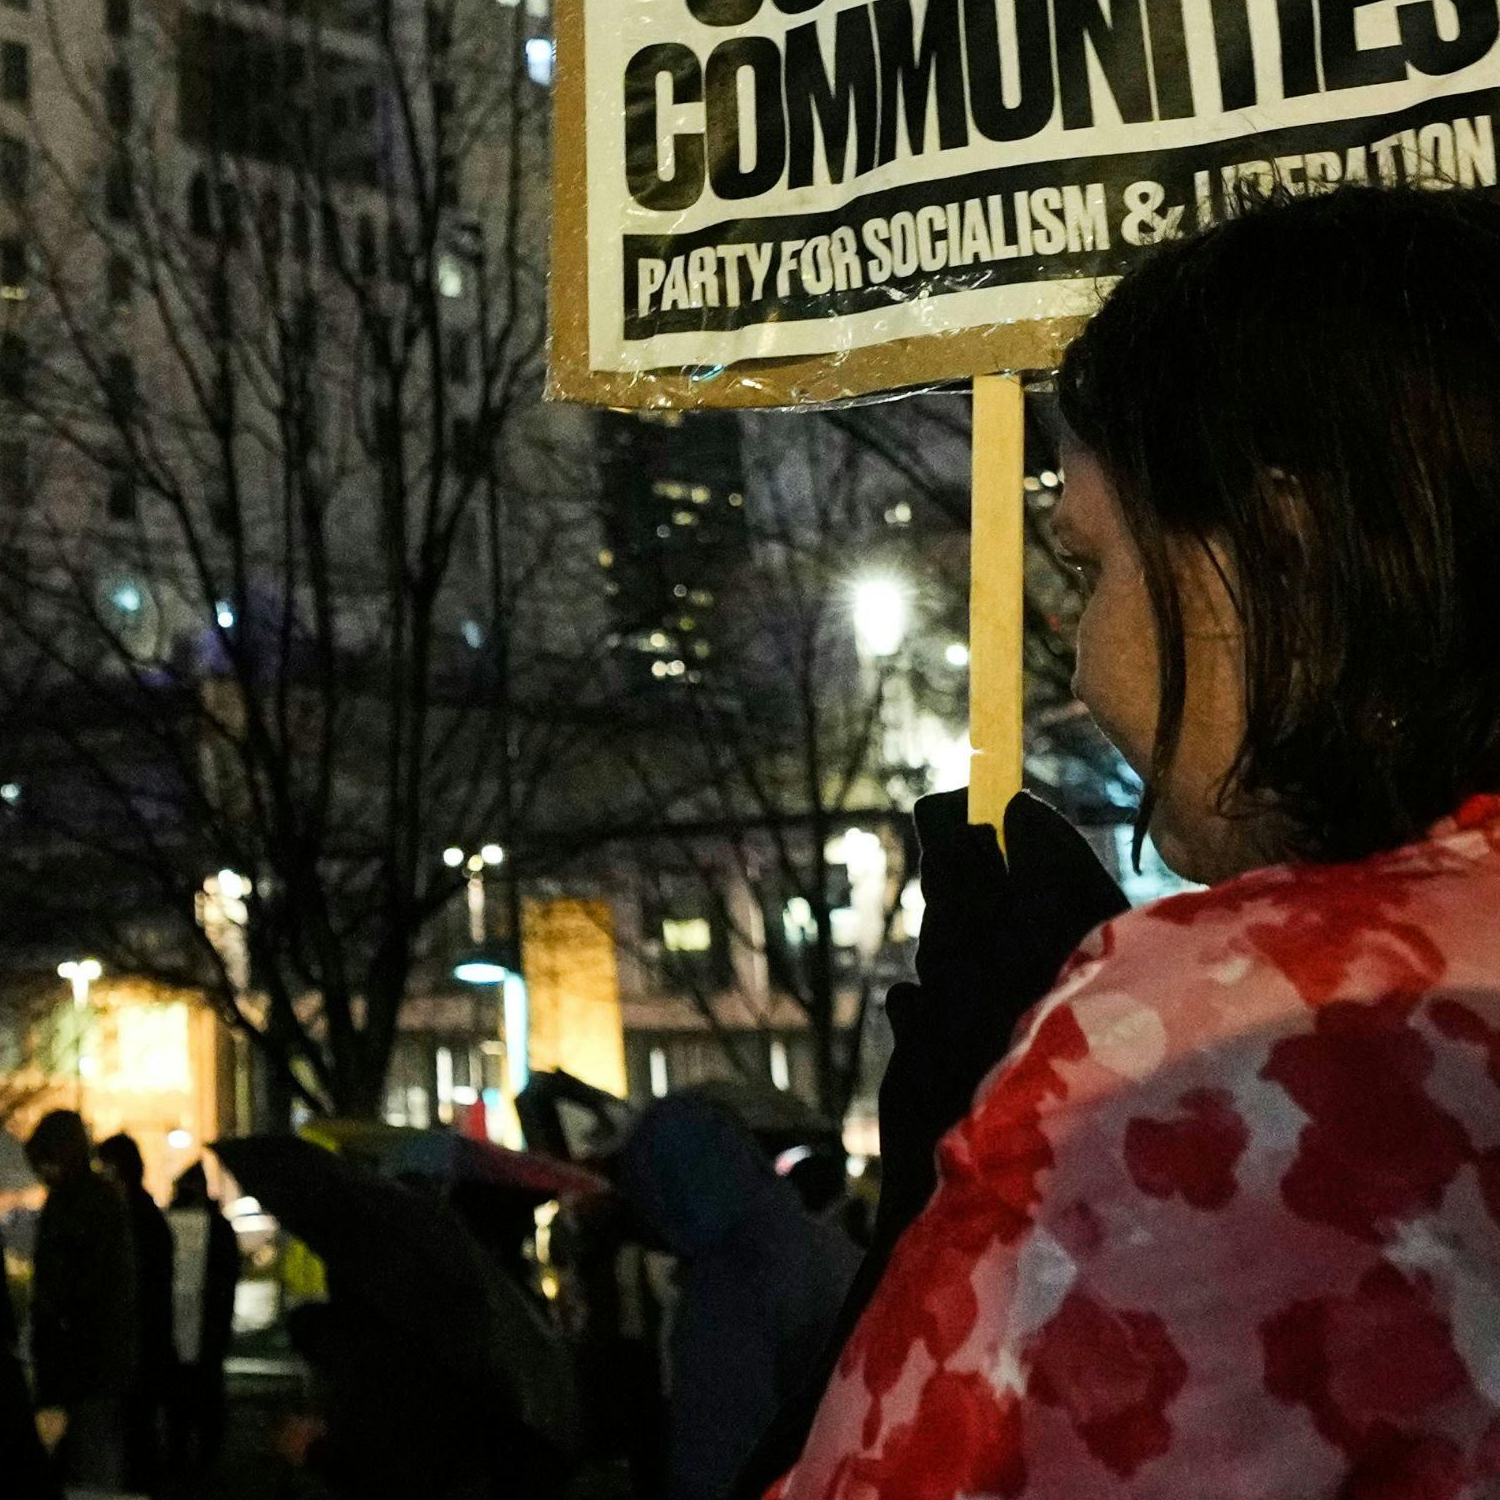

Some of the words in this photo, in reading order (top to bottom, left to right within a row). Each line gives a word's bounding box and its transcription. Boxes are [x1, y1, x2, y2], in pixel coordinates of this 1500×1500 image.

[638, 242, 773, 318] PARTY
[776, 226, 863, 297] FOR
[866, 183, 1110, 285] SOCIALISM
[1121, 180, 1186, 246] &
